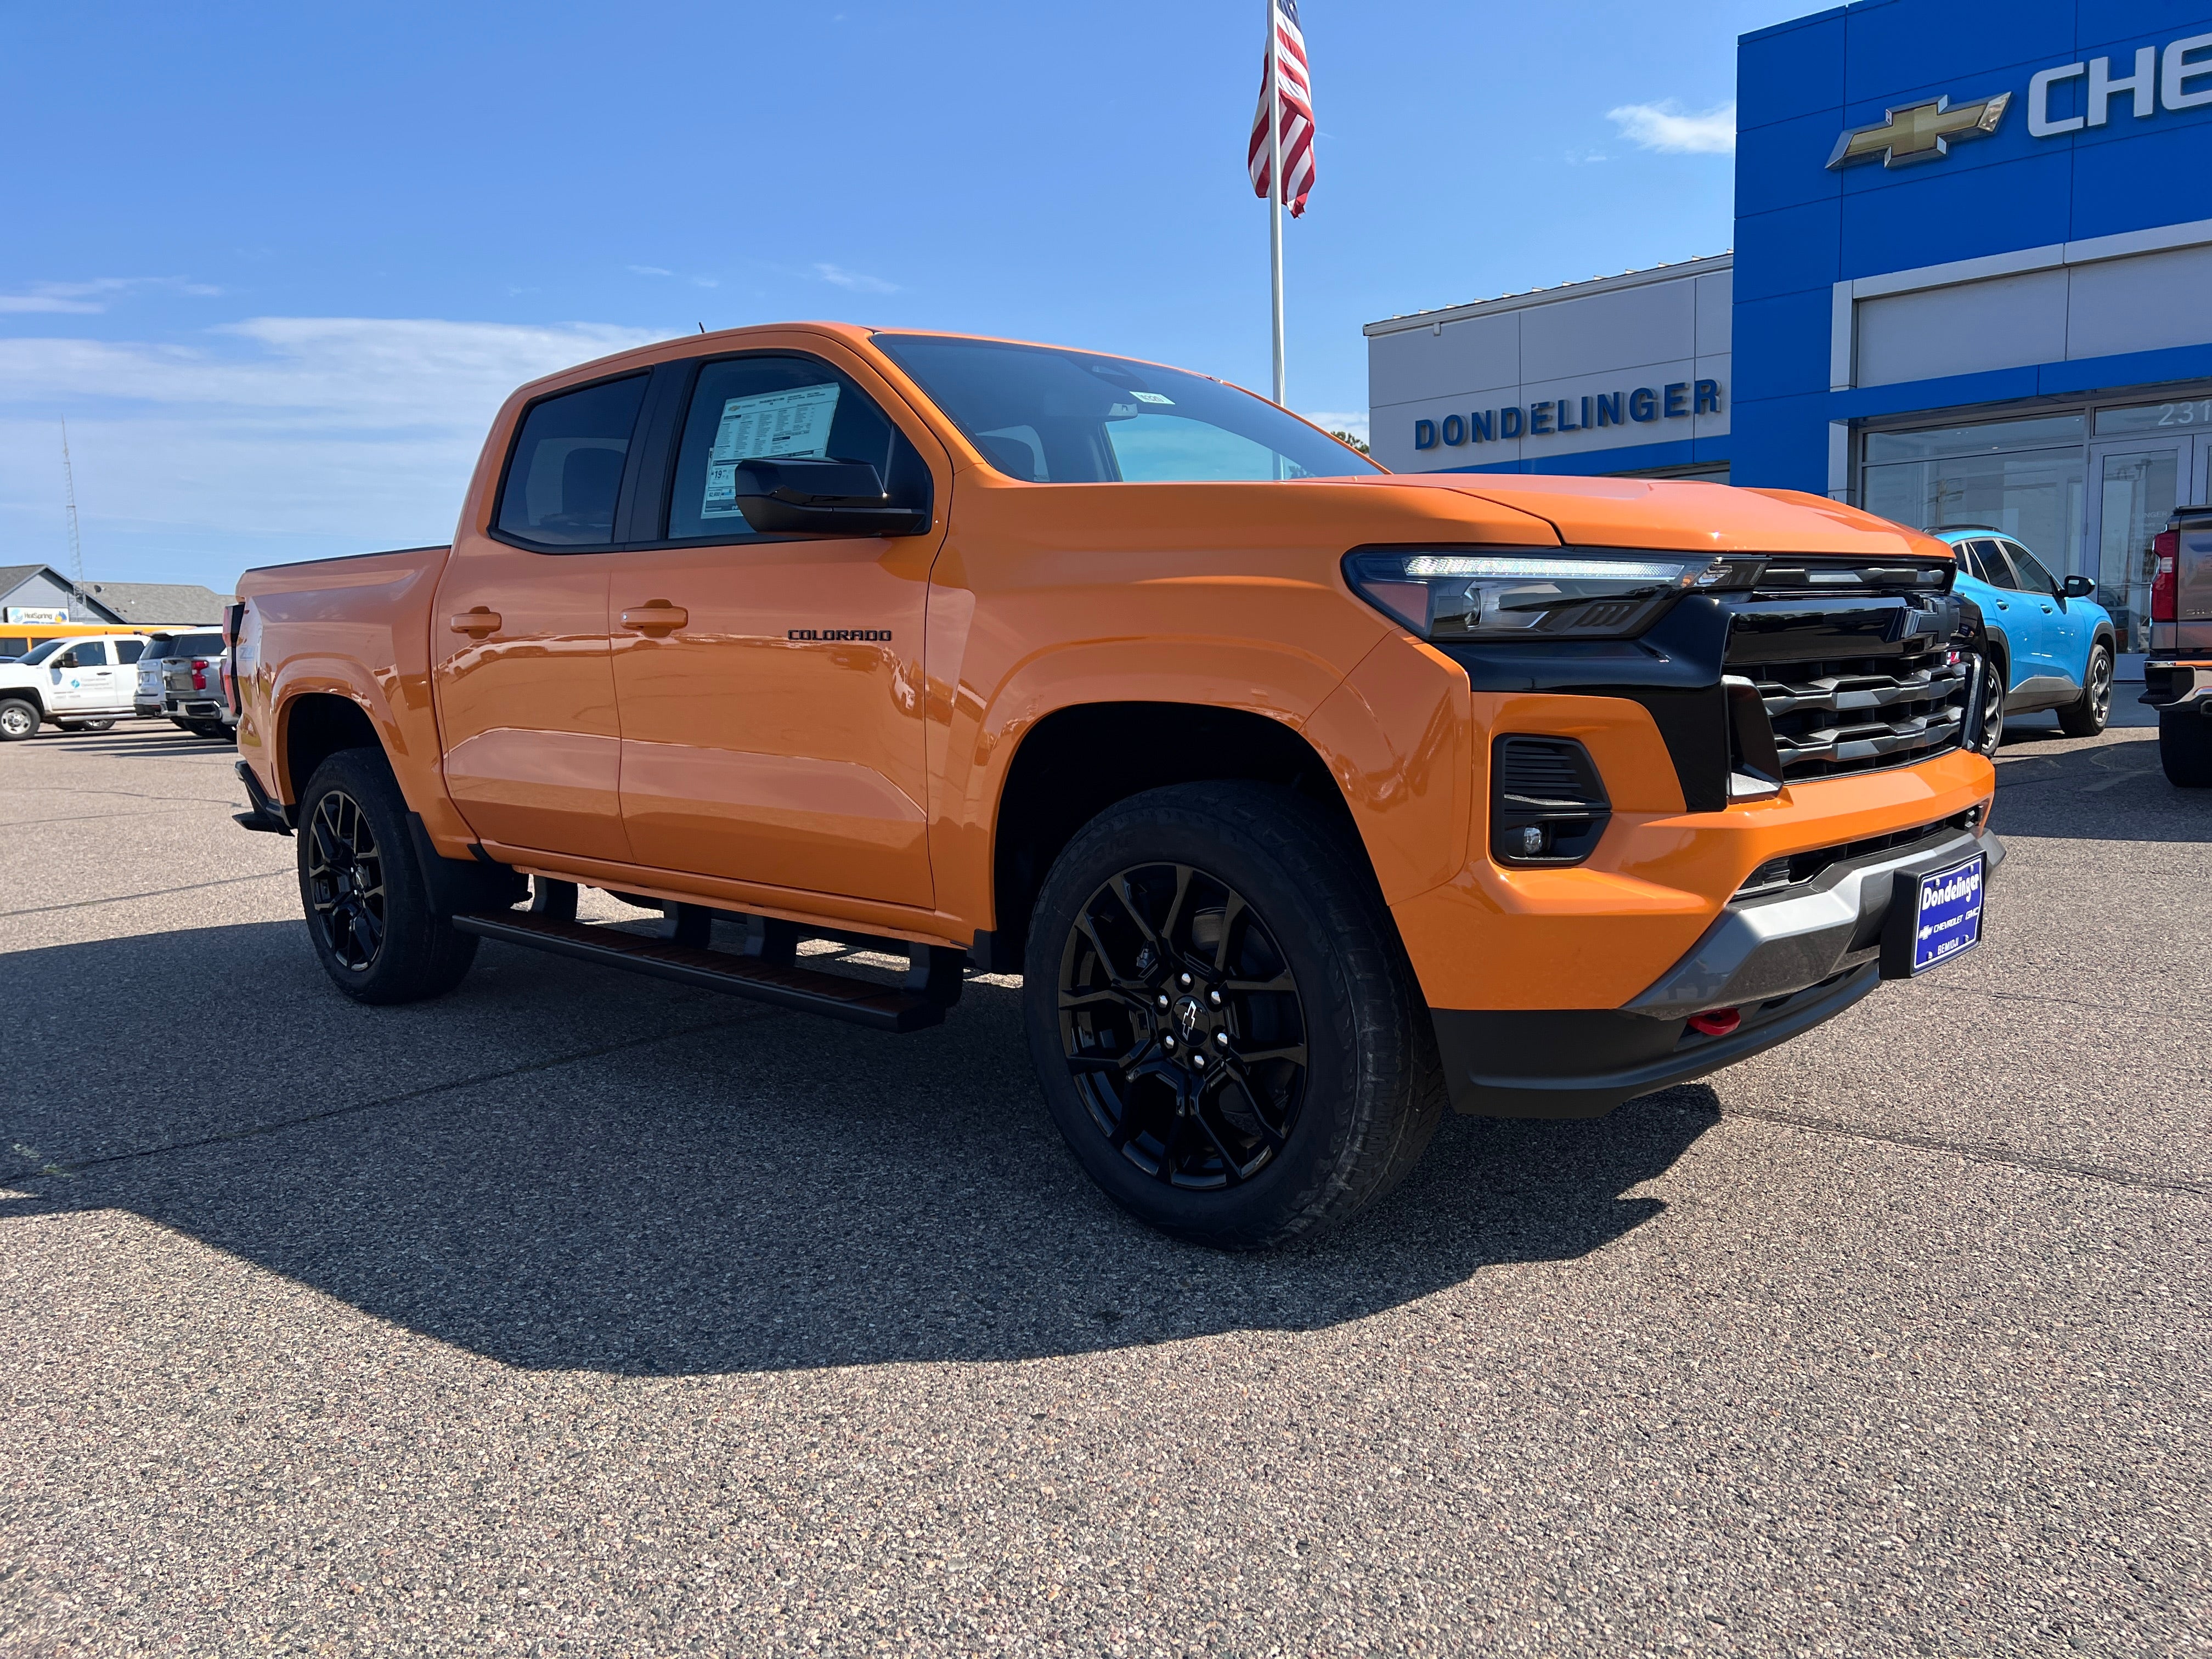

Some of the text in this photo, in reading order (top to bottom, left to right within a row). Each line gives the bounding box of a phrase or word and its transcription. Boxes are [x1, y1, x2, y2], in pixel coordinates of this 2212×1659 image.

[2028, 32, 2212, 137] CHE
[1415, 379, 1722, 451] DONDELINGER
[2158, 400, 2210, 426] 231
[788, 629, 892, 641] COLORADO
[1922, 873, 1979, 910] Dondelinger
[1933, 906, 1980, 933] CHEVROLET GMC
[1937, 937, 1959, 956] BEMIDJI
